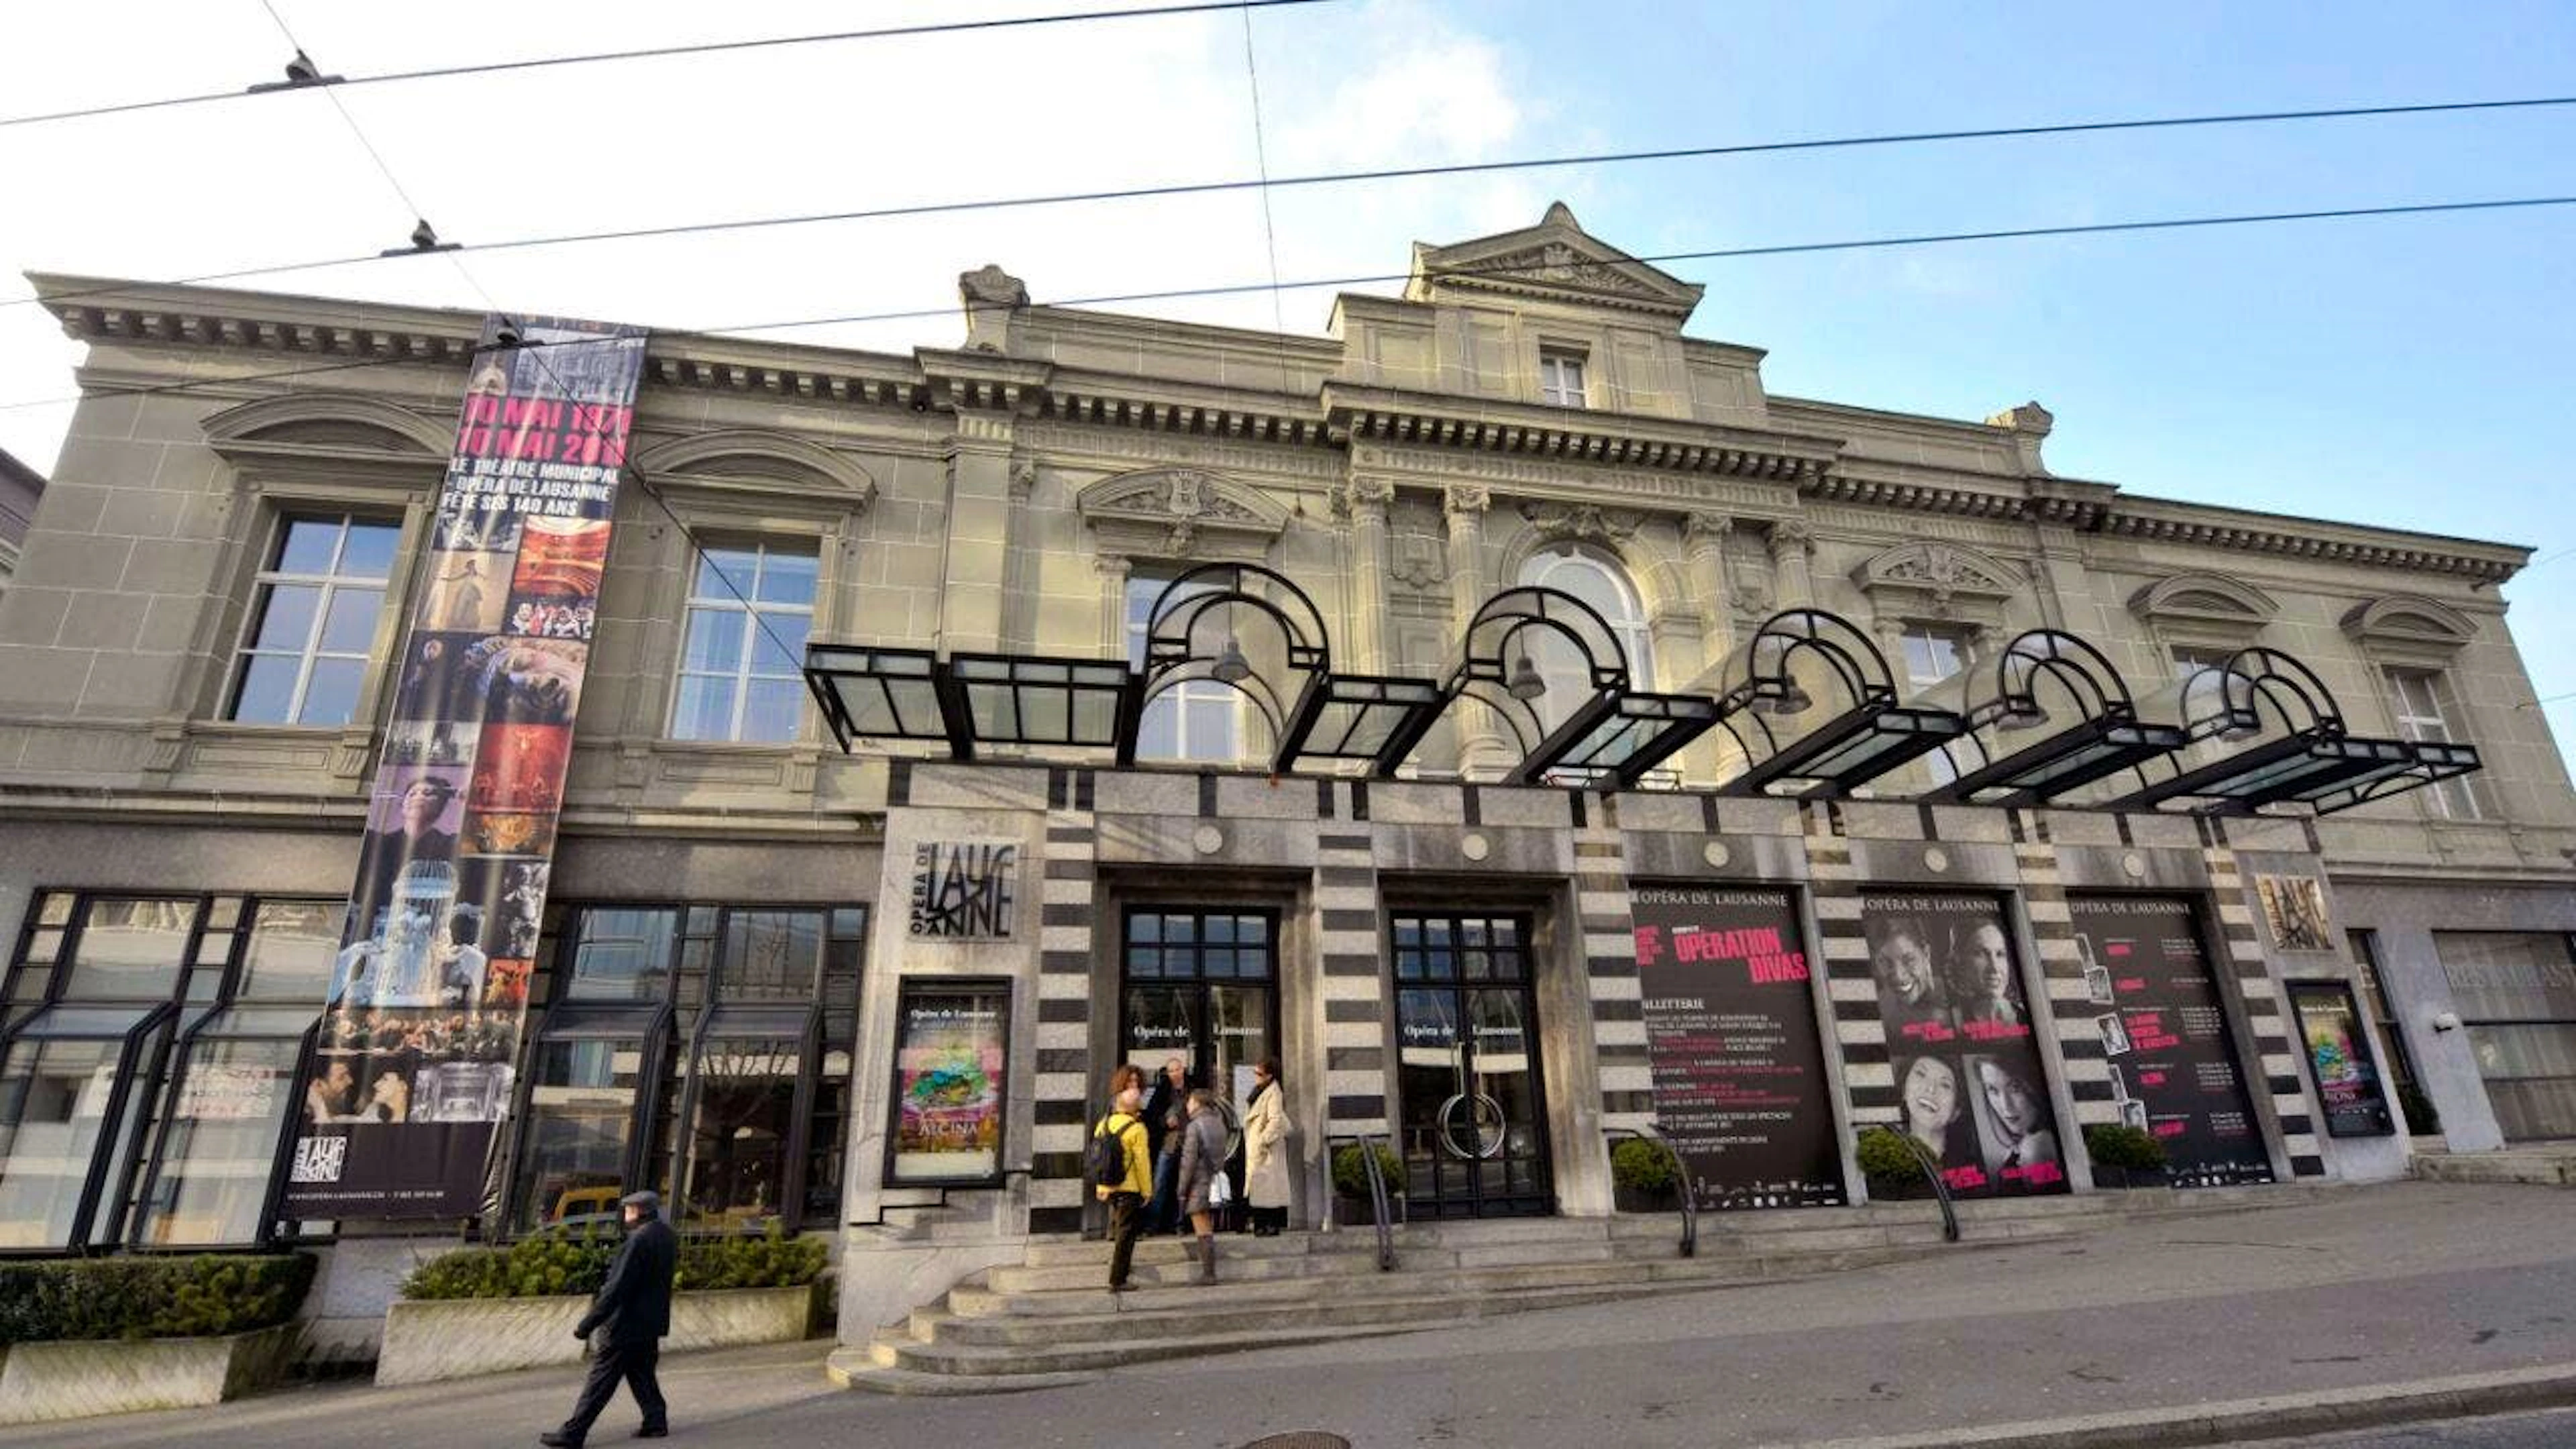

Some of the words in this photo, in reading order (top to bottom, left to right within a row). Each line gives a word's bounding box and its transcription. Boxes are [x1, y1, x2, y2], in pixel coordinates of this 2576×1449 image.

[465, 395, 498, 424] 10
[504, 397, 564, 427] MAI
[458, 427, 491, 457] 10
[496, 427, 557, 460] MAI
[449, 456, 469, 472] LE
[508, 477, 527, 494] DE
[530, 478, 612, 502] LAUSANNE
[480, 494, 510, 512] SES
[513, 495, 543, 514] 140
[544, 498, 579, 517] ANS
[1691, 891, 1710, 906] DE
[1714, 893, 1788, 907] LAUSANNE
[1748, 951, 1809, 984] DIVAS
